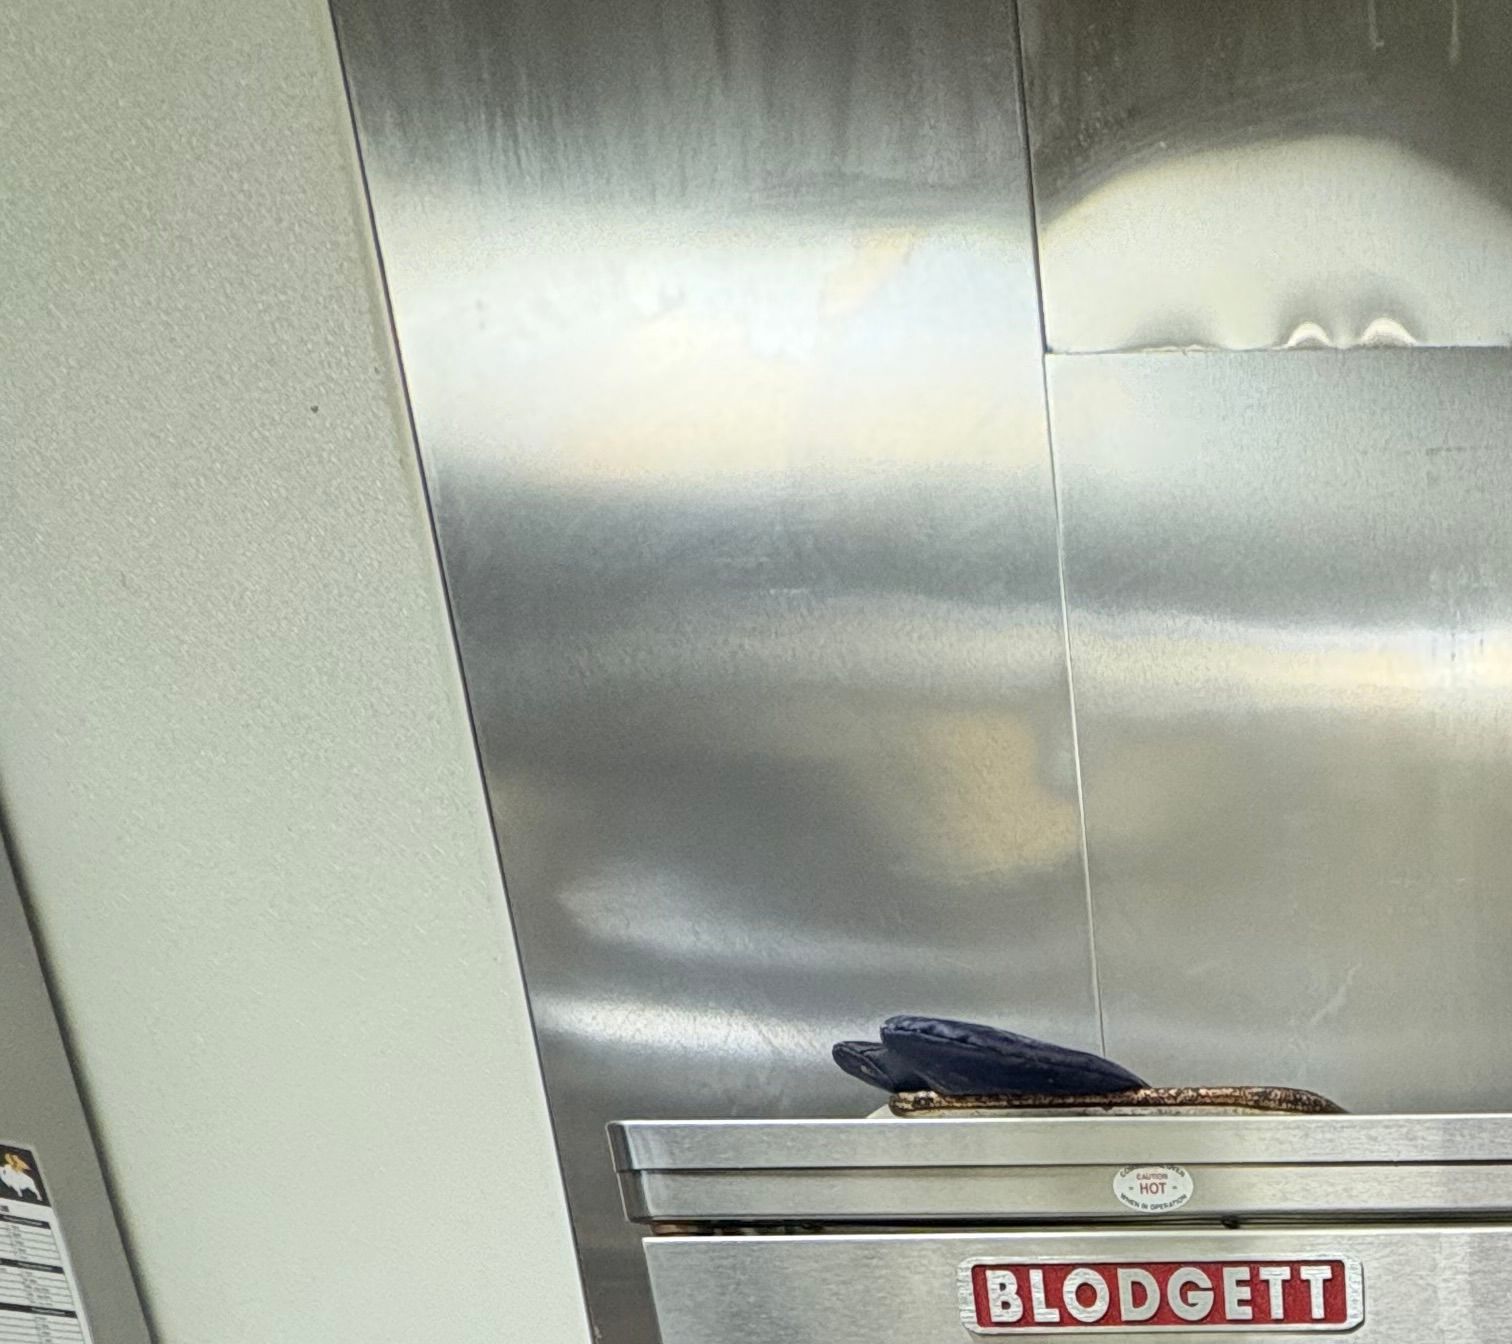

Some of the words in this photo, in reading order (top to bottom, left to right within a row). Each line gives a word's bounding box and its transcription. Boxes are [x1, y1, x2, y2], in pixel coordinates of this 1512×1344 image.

[1136, 1173, 1169, 1181] CAUTION
[1140, 1182, 1167, 1195] HOT
[1120, 1192, 1141, 1209] WHEN
[1141, 1202, 1148, 1210] IN
[1149, 1193, 1188, 1211] OPERATION
[985, 1265, 1332, 1324] BLODGETT
